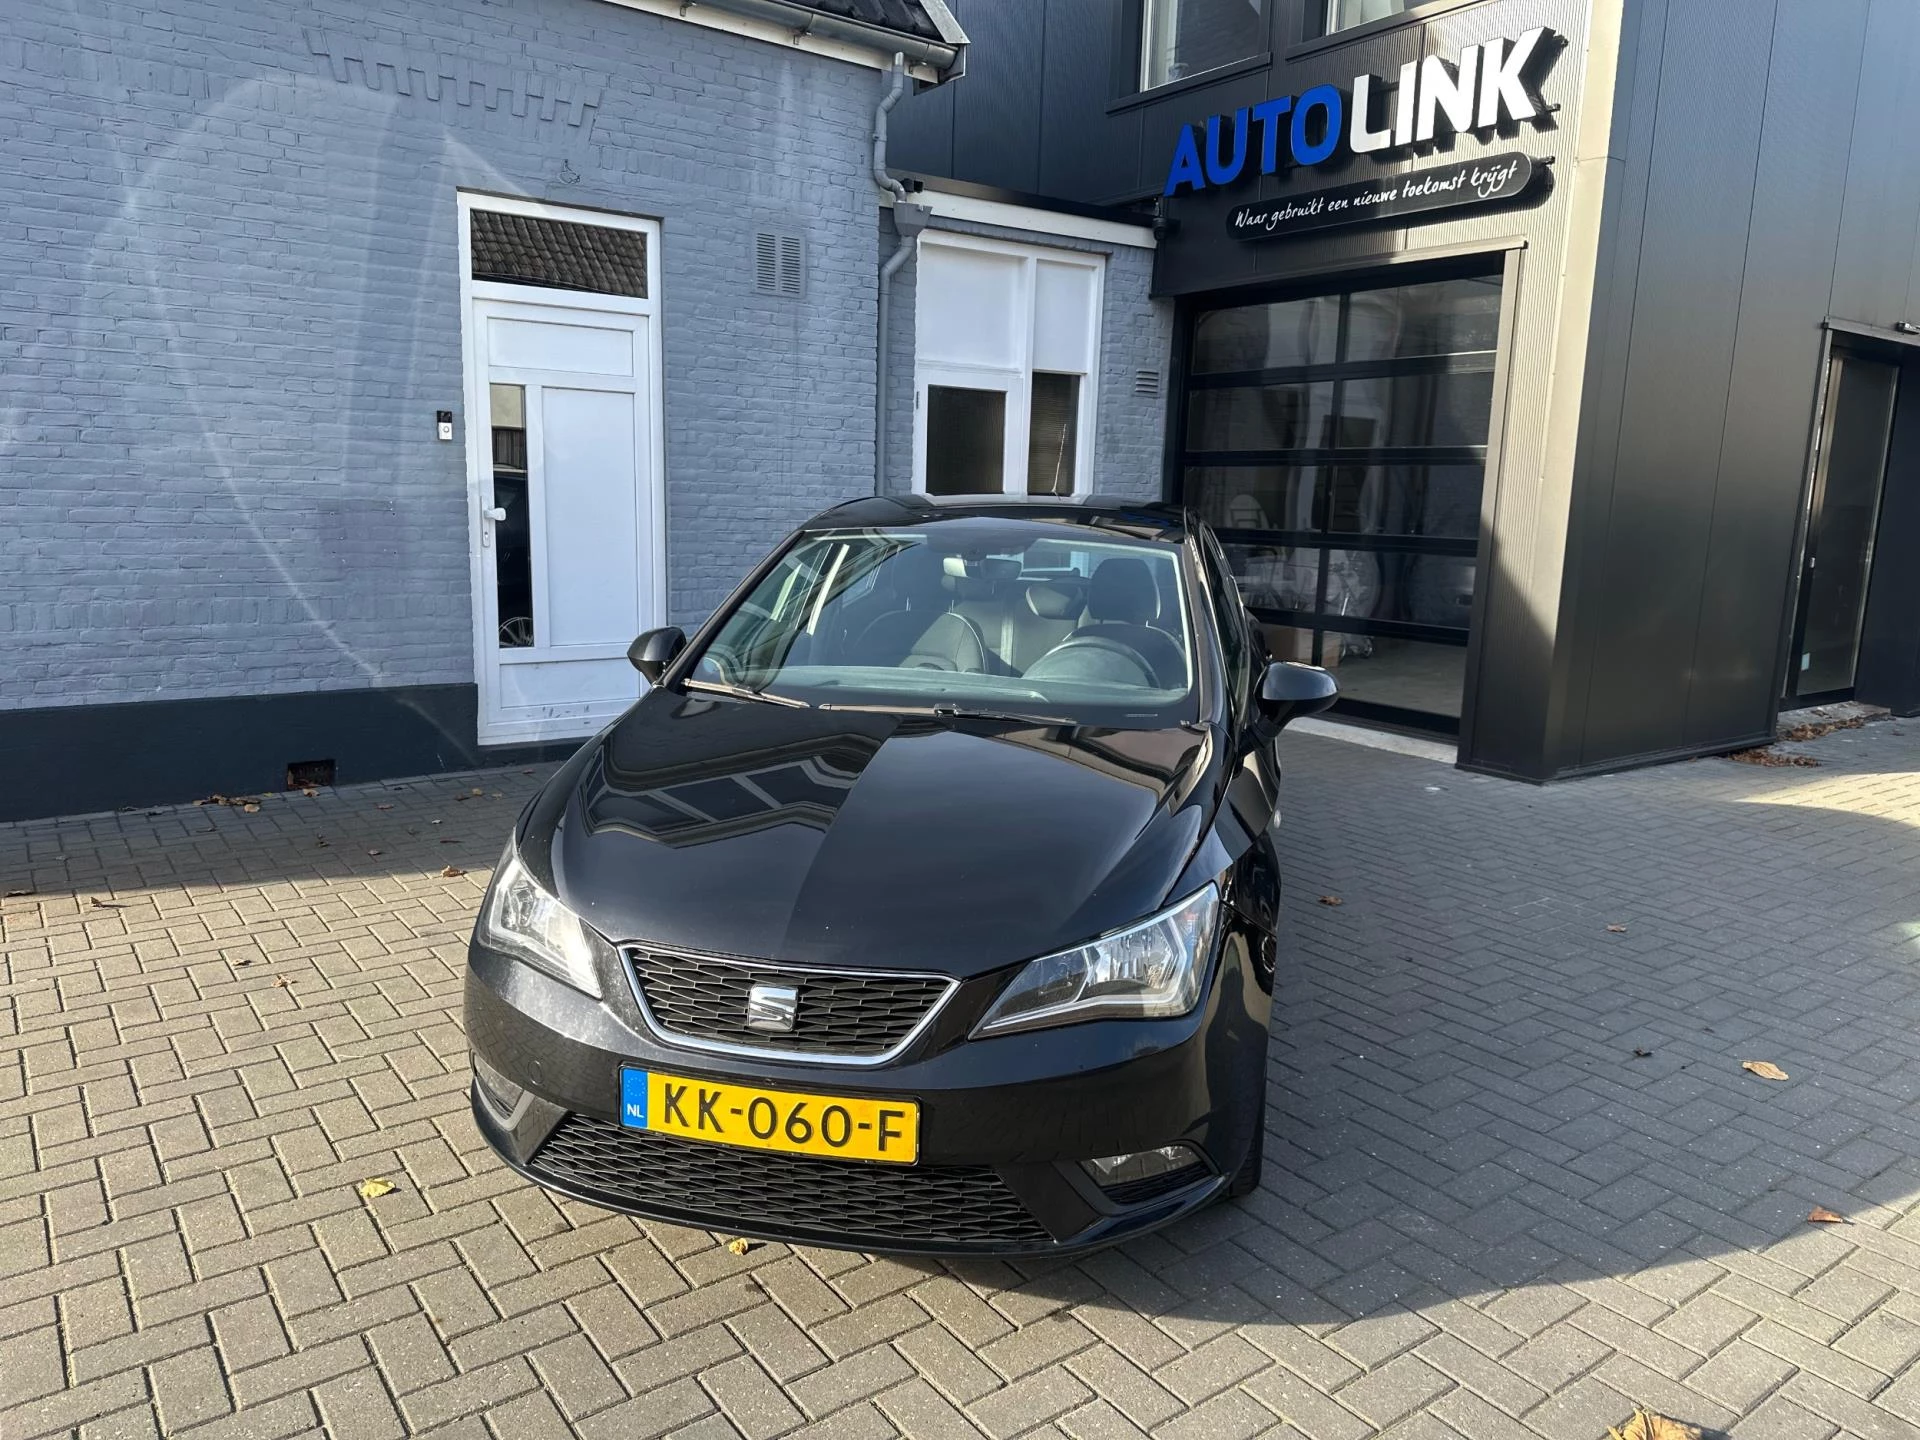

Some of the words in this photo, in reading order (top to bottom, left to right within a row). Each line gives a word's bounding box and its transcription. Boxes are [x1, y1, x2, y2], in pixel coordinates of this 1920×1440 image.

[1235, 207, 1268, 228] Waar
[1265, 196, 1325, 231] gebruikt
[1327, 199, 1349, 212] een
[1353, 188, 1398, 206] nieuwe
[1402, 169, 1467, 199] toekomst
[1470, 159, 1518, 198] krijgt
[627, 1103, 644, 1119] NL
[664, 1082, 905, 1152] KK-060-F
